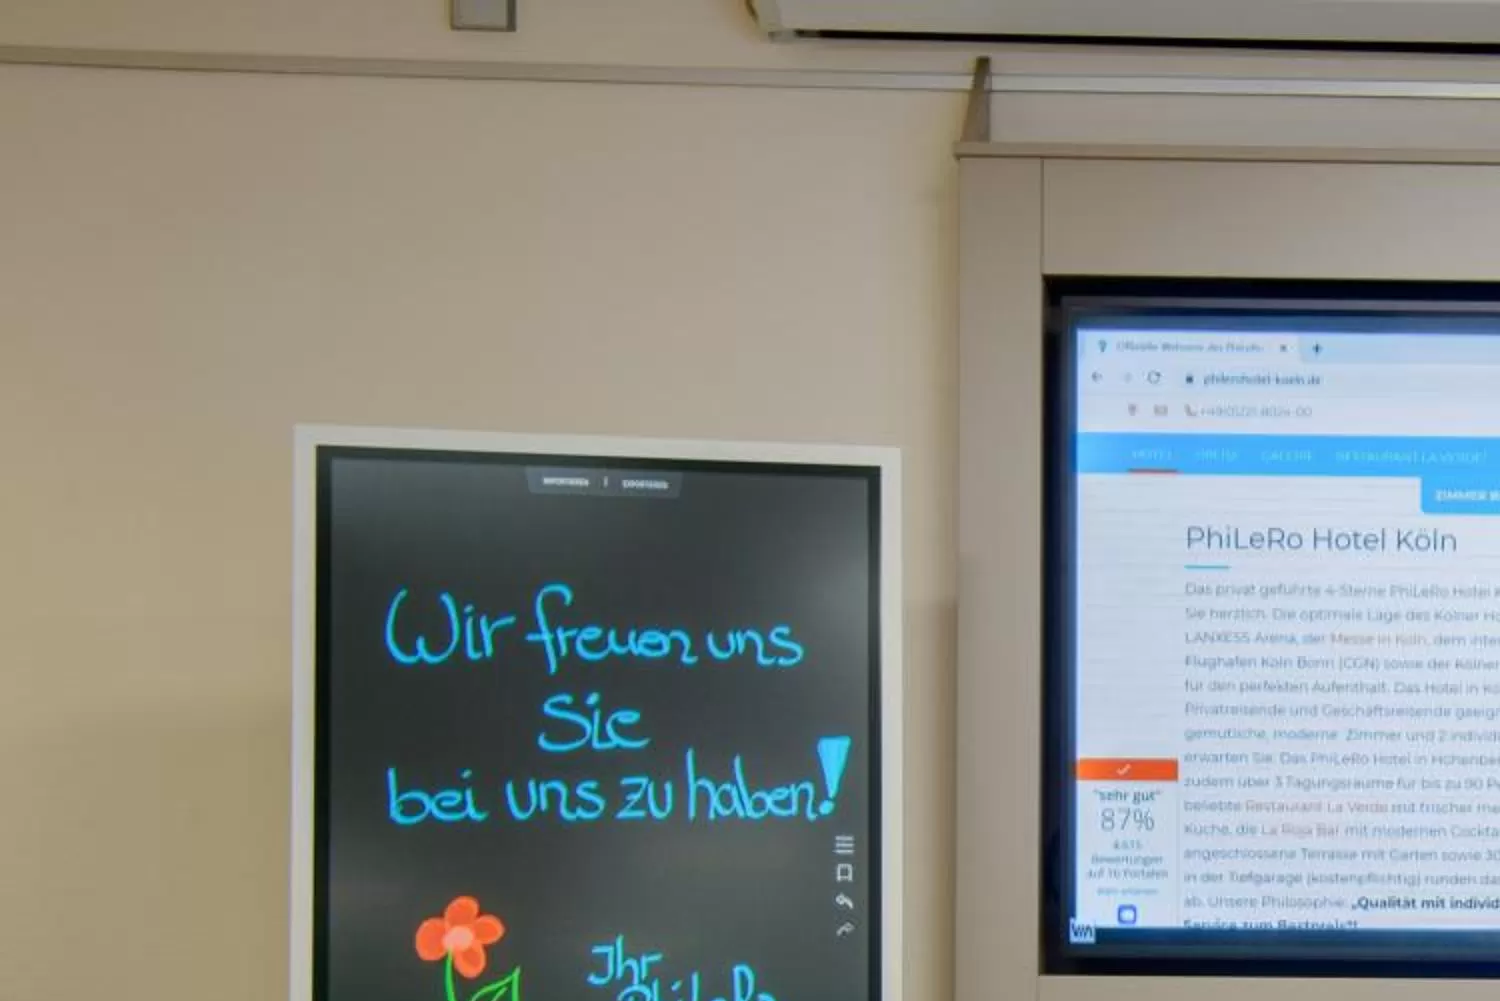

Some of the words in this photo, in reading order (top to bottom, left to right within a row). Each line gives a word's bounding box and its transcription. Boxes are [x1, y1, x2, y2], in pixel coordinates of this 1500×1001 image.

[1435, 489, 1487, 503] ZIMMER
[1186, 524, 1303, 551] PhiLeRo
[1312, 526, 1387, 552] Hotel
[1396, 526, 1458, 553] Köln
[385, 589, 516, 663] Wir
[525, 583, 698, 674] freuen
[706, 625, 803, 665] uns
[538, 692, 649, 751] Sie
[388, 767, 488, 824] bei
[505, 775, 606, 821] uns
[615, 775, 673, 820] zu
[686, 736, 851, 821] haben!
[1101, 807, 1155, 832] 87%
